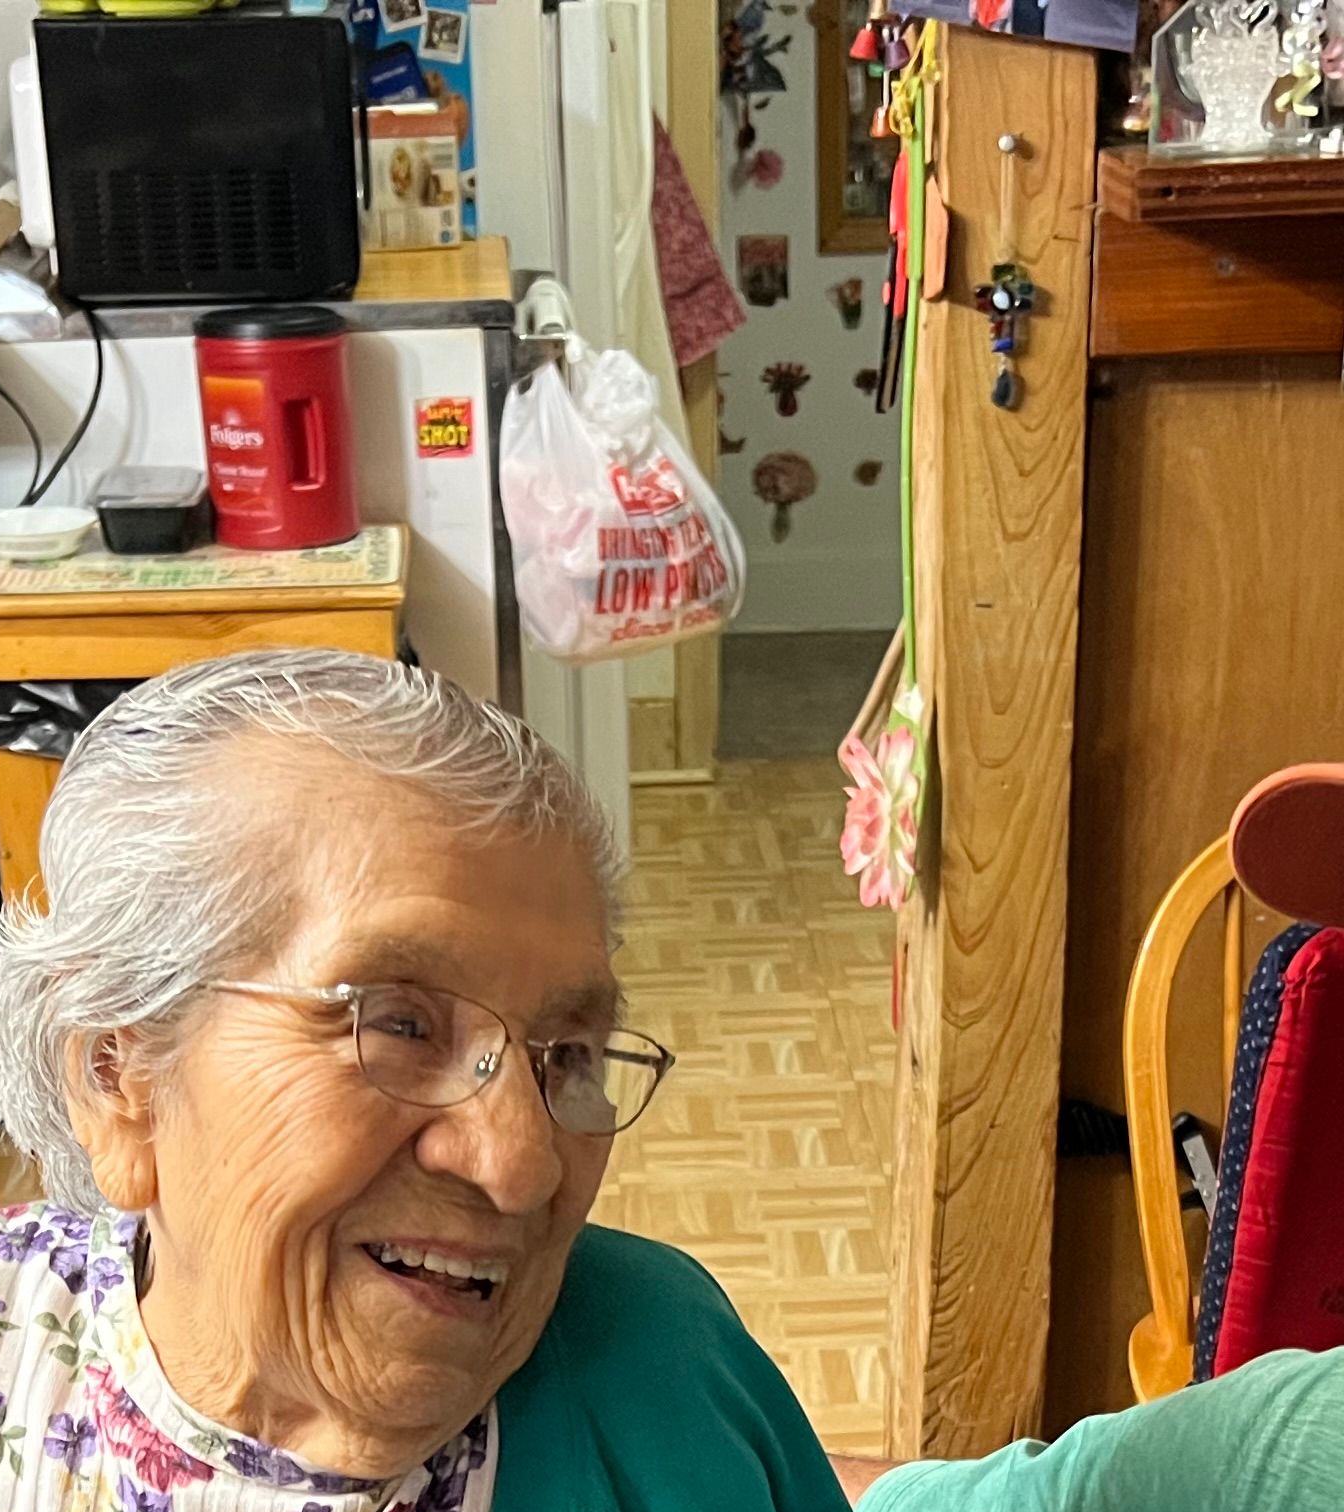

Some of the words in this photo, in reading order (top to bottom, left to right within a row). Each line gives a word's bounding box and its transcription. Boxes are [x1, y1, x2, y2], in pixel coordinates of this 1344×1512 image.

[210, 425, 264, 450] Folgers
[419, 425, 468, 446] SHOT
[595, 567, 655, 614] LOW
